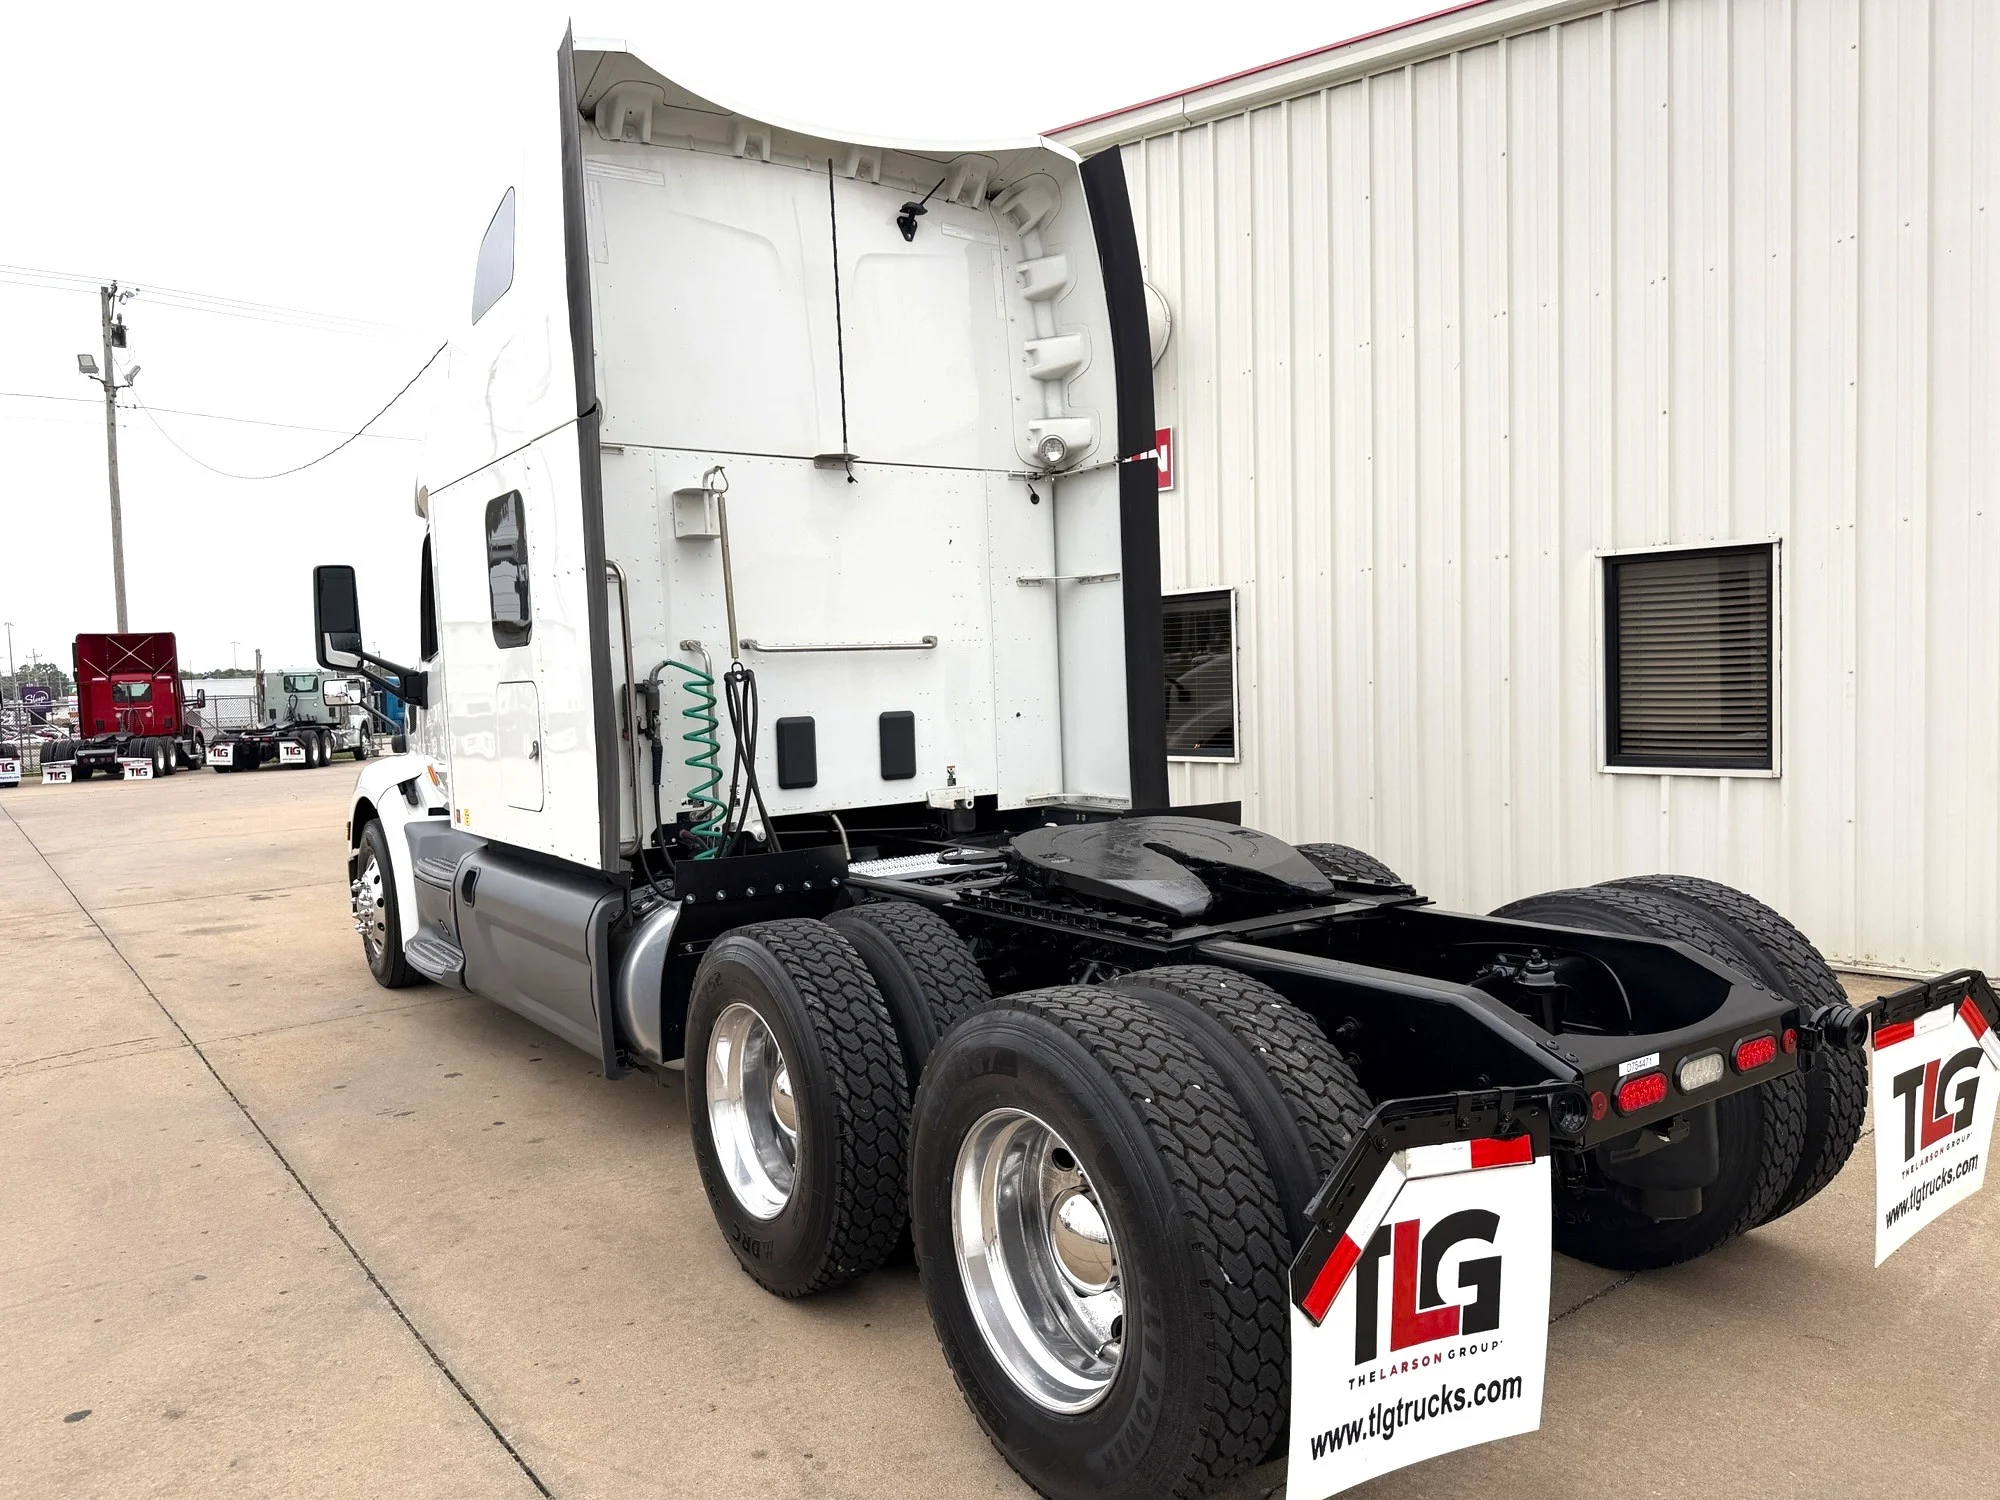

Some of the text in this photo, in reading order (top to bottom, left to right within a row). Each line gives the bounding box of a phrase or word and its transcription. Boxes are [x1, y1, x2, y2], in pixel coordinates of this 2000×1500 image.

[283, 746, 301, 756] TLG
[47, 771, 67, 781] TLG
[128, 767, 148, 777] TLG
[1893, 1047, 1985, 1163] TLG
[1946, 1133, 1971, 1151] GROUP
[1885, 1153, 1979, 1230] www.tlgtrucks.com
[1355, 1208, 1503, 1366] TLG
[1447, 1340, 1500, 1360] GROUP
[1310, 1375, 1522, 1461] www.tlgtrucks.com
